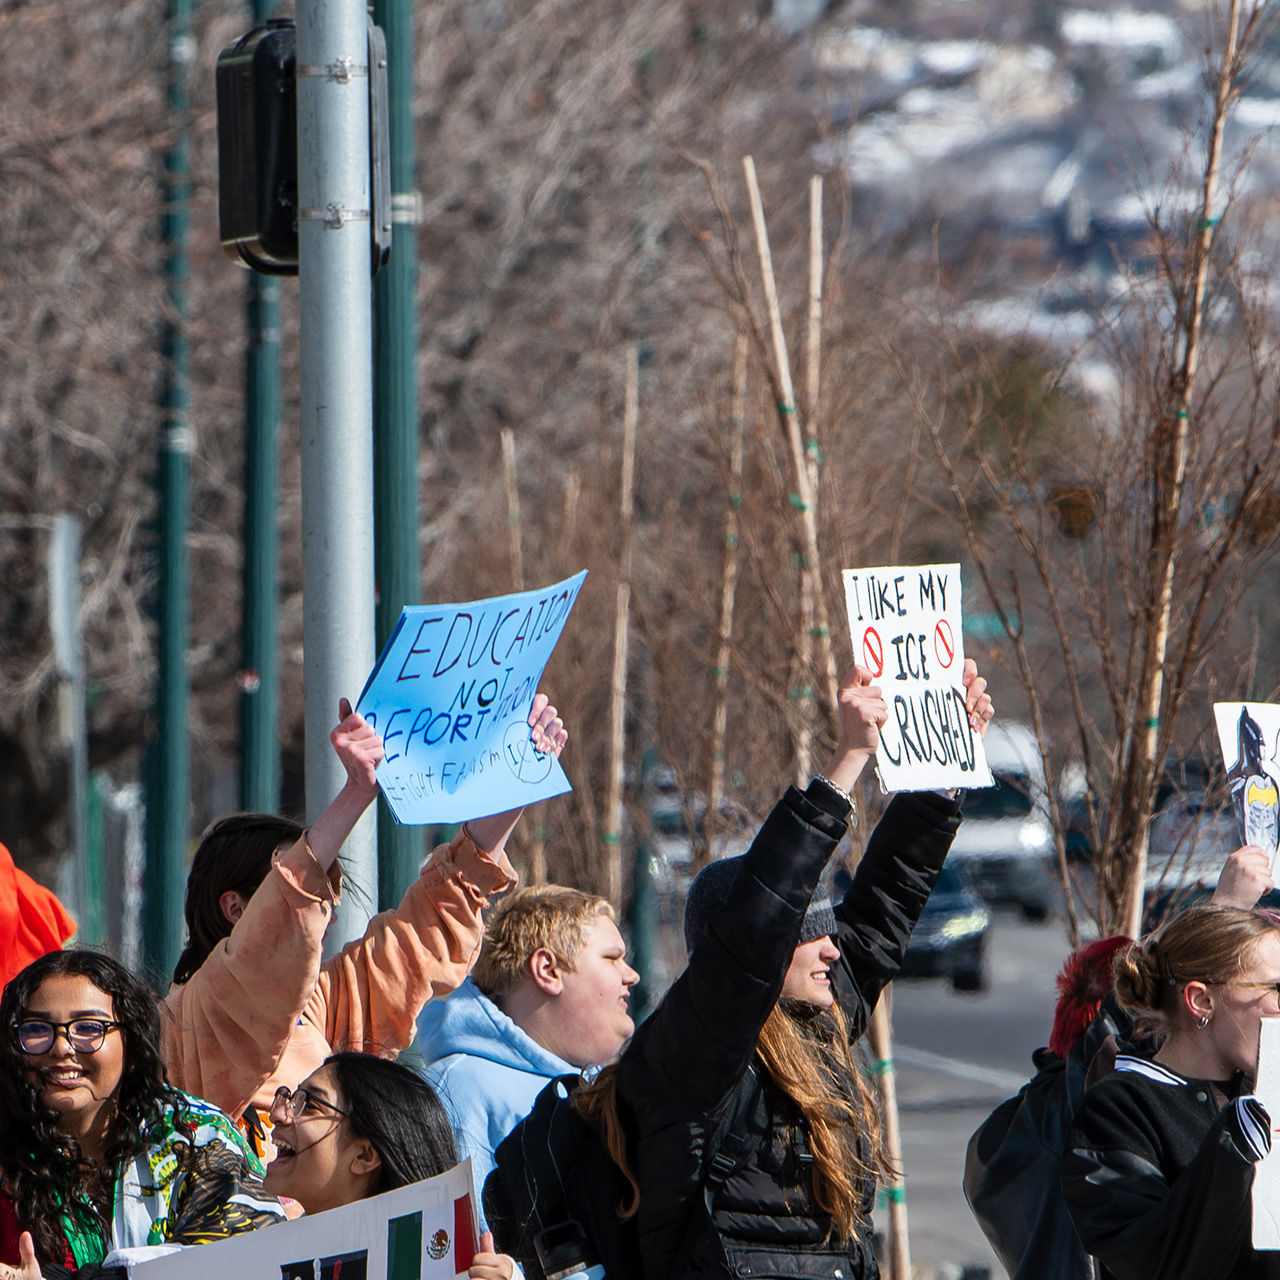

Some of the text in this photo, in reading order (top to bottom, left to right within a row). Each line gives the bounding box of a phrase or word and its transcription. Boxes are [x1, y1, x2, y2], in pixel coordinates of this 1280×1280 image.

[852, 575, 864, 621] I
[918, 569, 949, 612] MY
[890, 631, 931, 681] ICE
[449, 666, 515, 713] NOT
